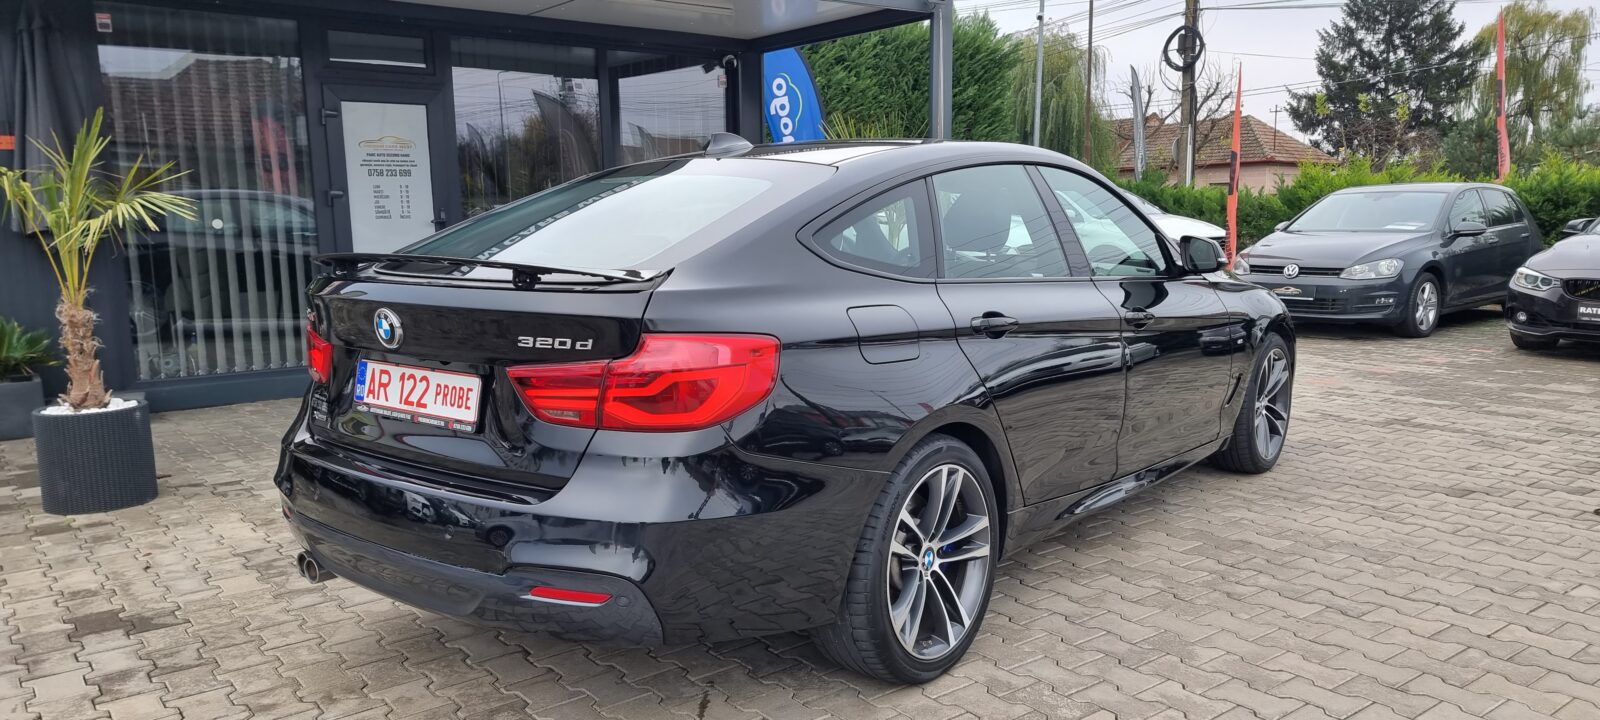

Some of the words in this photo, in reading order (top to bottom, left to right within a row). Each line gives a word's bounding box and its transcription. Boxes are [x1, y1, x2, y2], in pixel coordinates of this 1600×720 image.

[367, 168, 385, 177] 0758
[385, 169, 397, 177] 233
[356, 383, 365, 397] RO
[366, 367, 392, 402] AR
[399, 371, 430, 409] 122
[434, 382, 473, 411] PROBE
